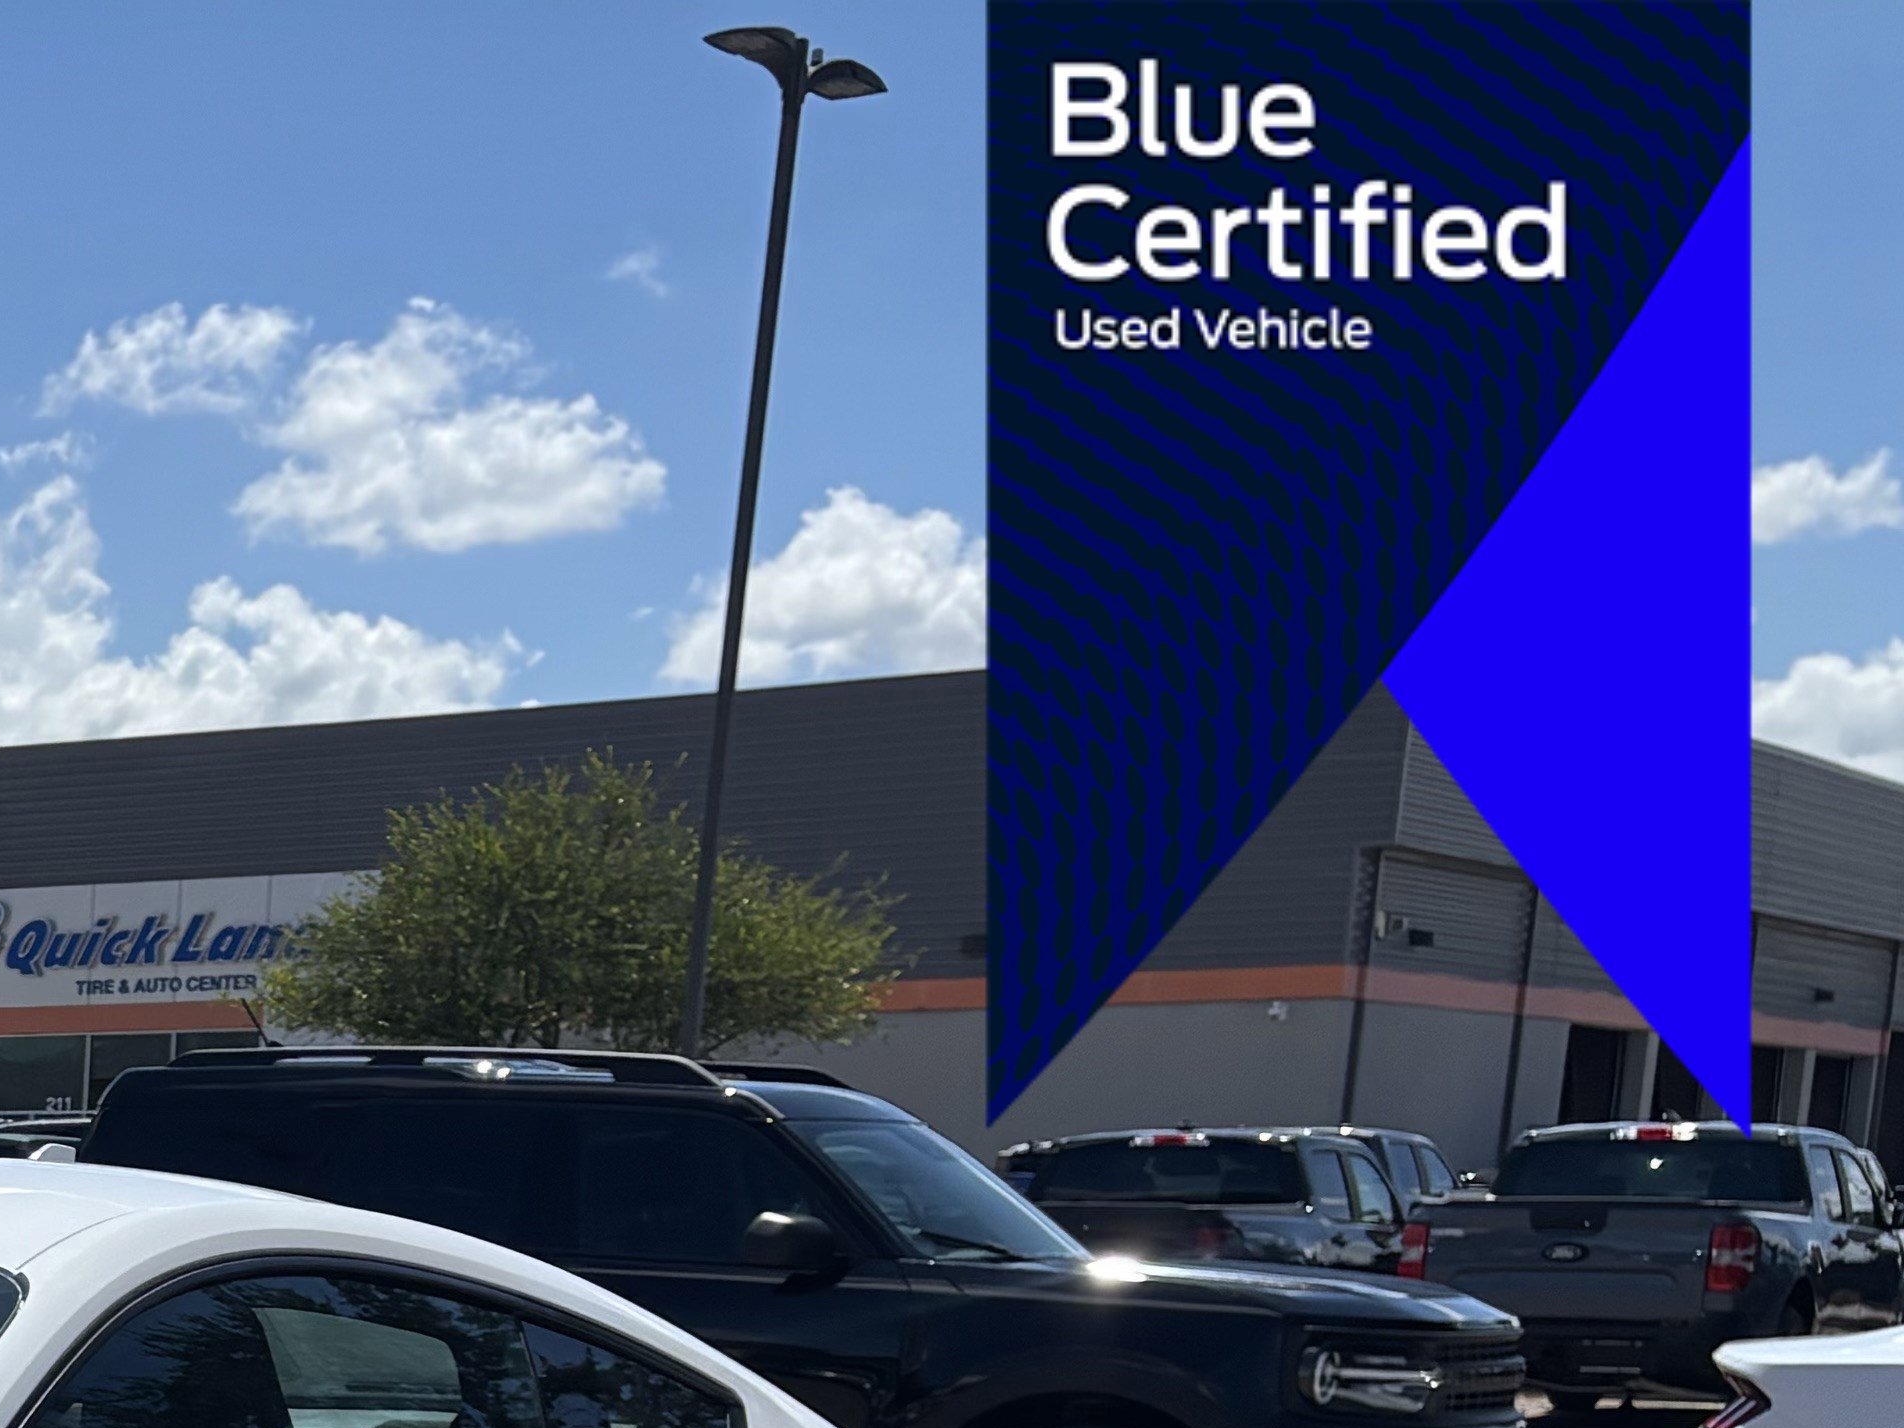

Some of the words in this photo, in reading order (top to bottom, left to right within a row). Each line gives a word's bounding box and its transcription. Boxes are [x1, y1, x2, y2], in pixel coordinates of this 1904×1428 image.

[5, 914, 172, 976] Quick
[75, 979, 114, 996] TIRE
[118, 979, 130, 994] &
[133, 976, 183, 994] AUTO
[185, 974, 258, 992] CENTER
[45, 1096, 73, 1112] 211
